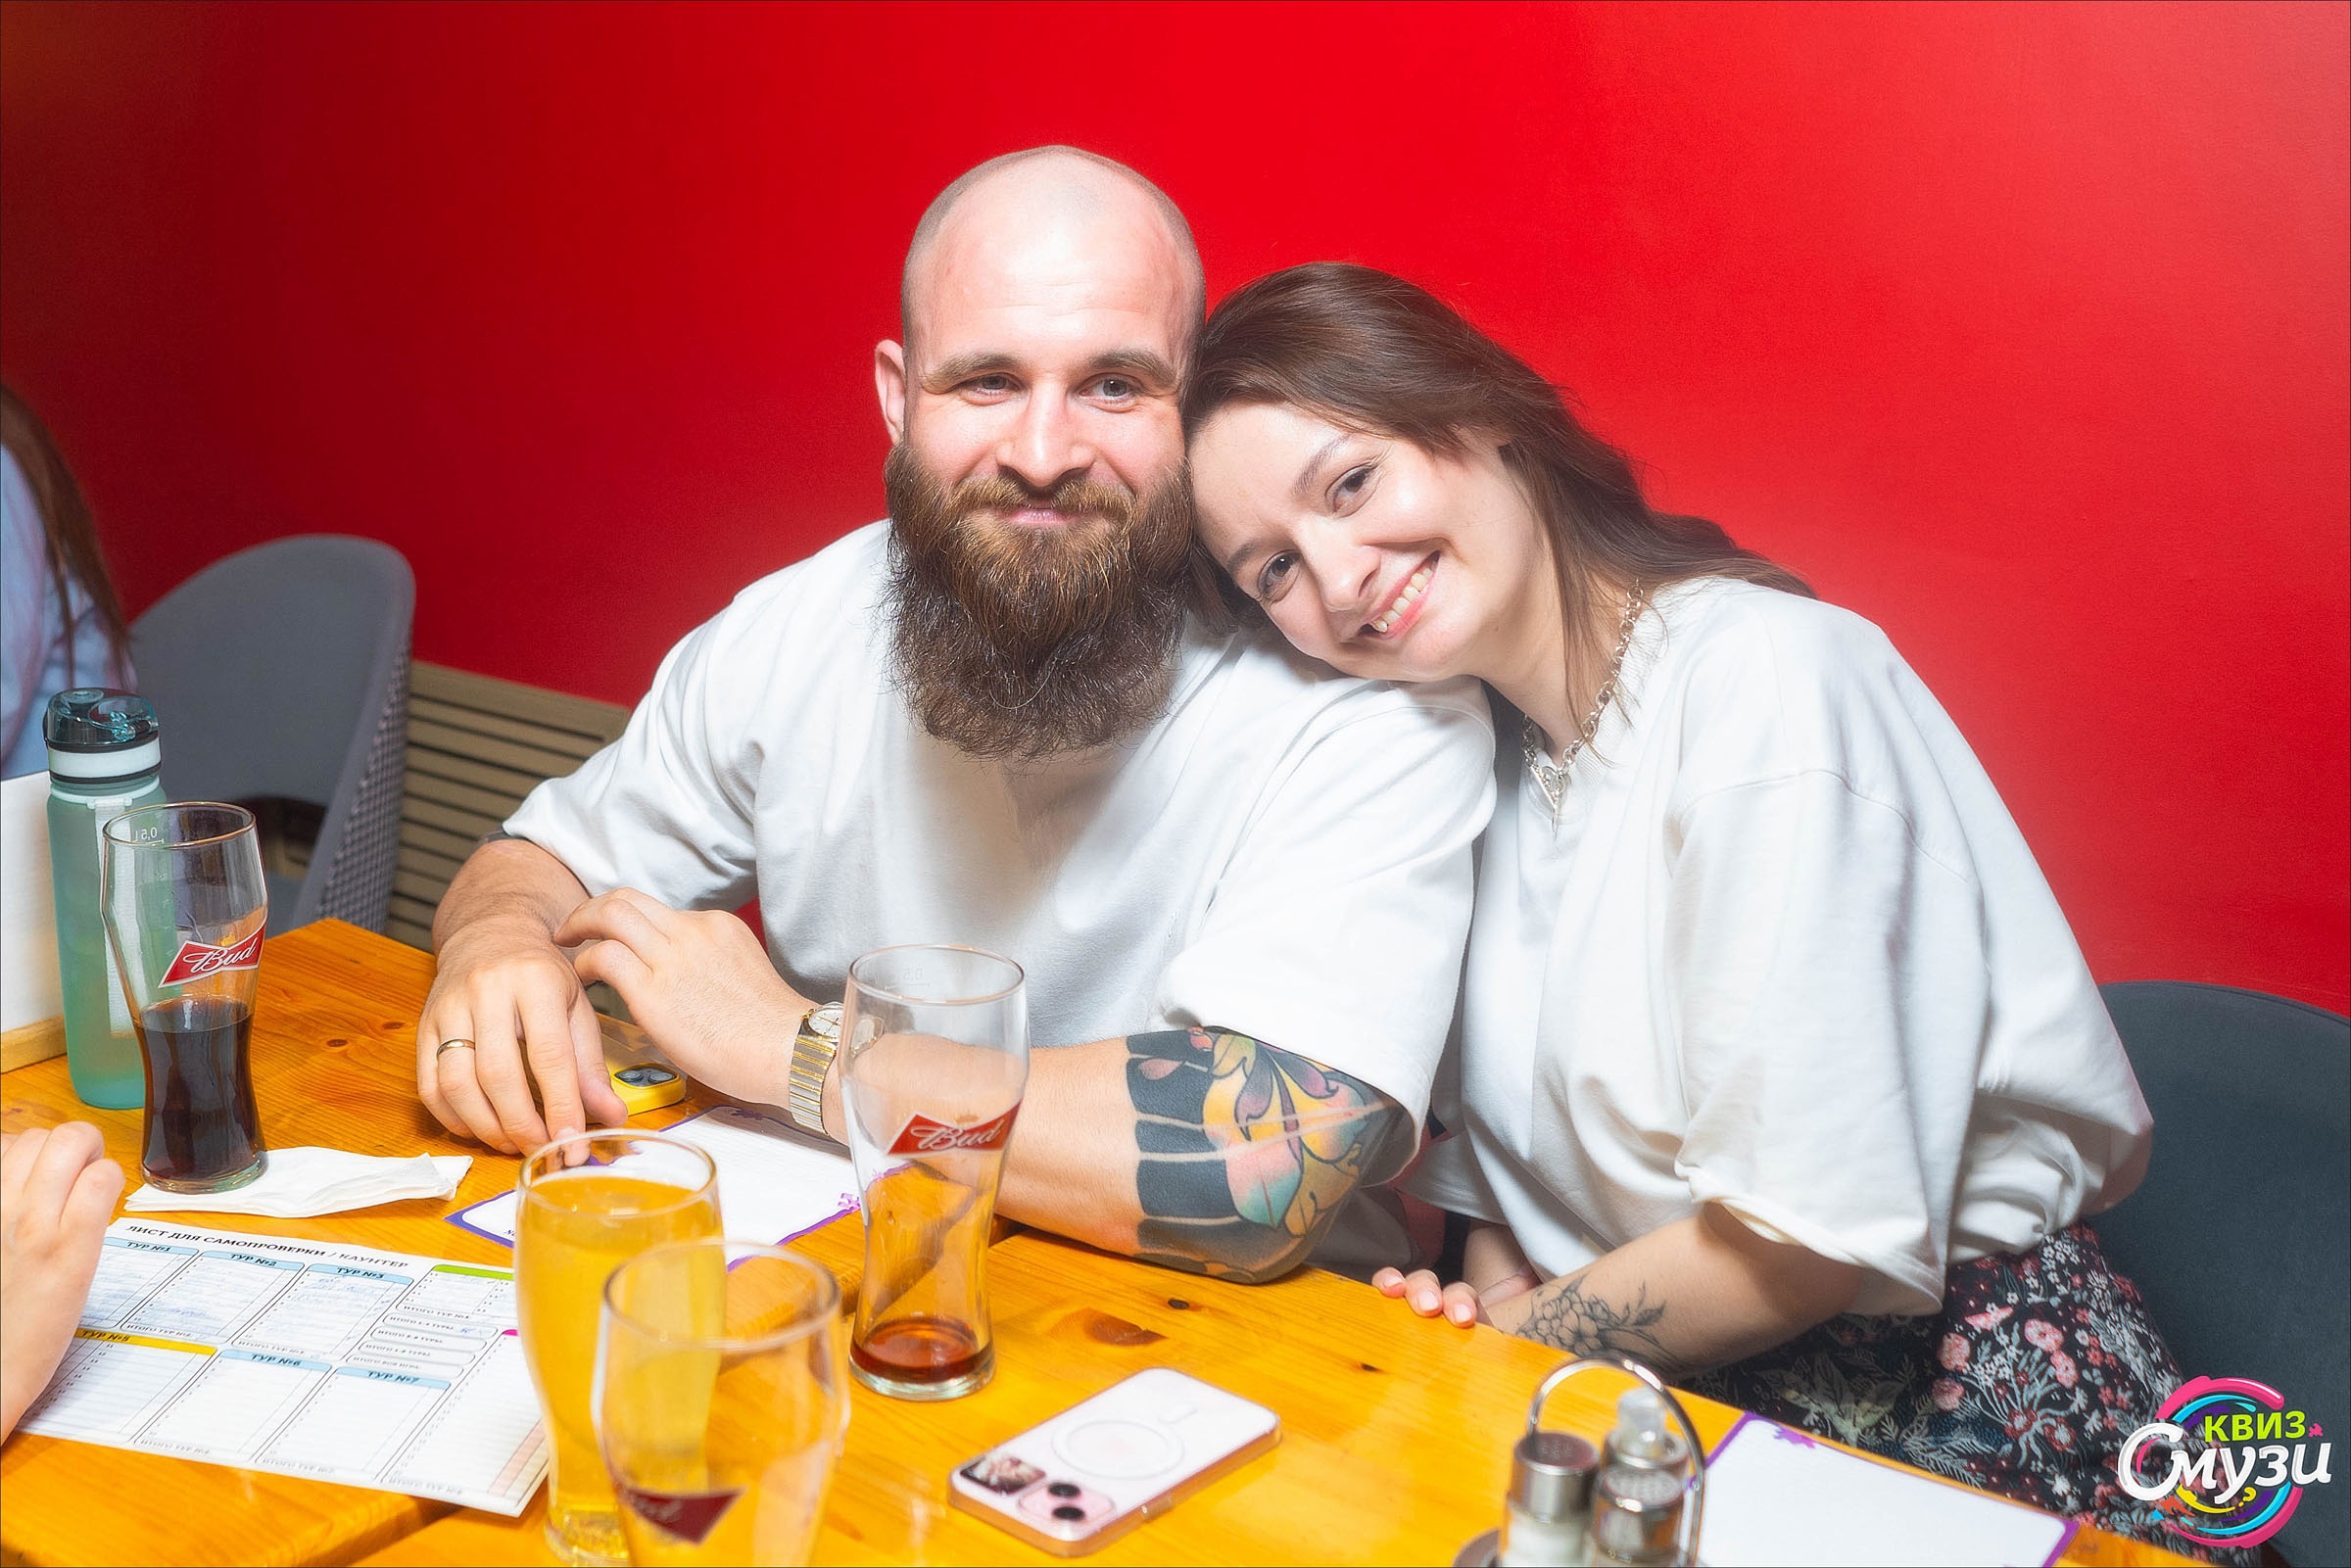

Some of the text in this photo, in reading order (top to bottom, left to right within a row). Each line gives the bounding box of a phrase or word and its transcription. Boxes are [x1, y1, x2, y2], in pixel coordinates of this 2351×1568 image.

[183, 937, 258, 973] Bud
[911, 1120, 1005, 1151] Bud
[125, 1225, 168, 1236] ЛИСТ
[169, 1232, 201, 1241] ДЛЯ
[204, 1237, 325, 1256] САМОПРОВЕРКИ
